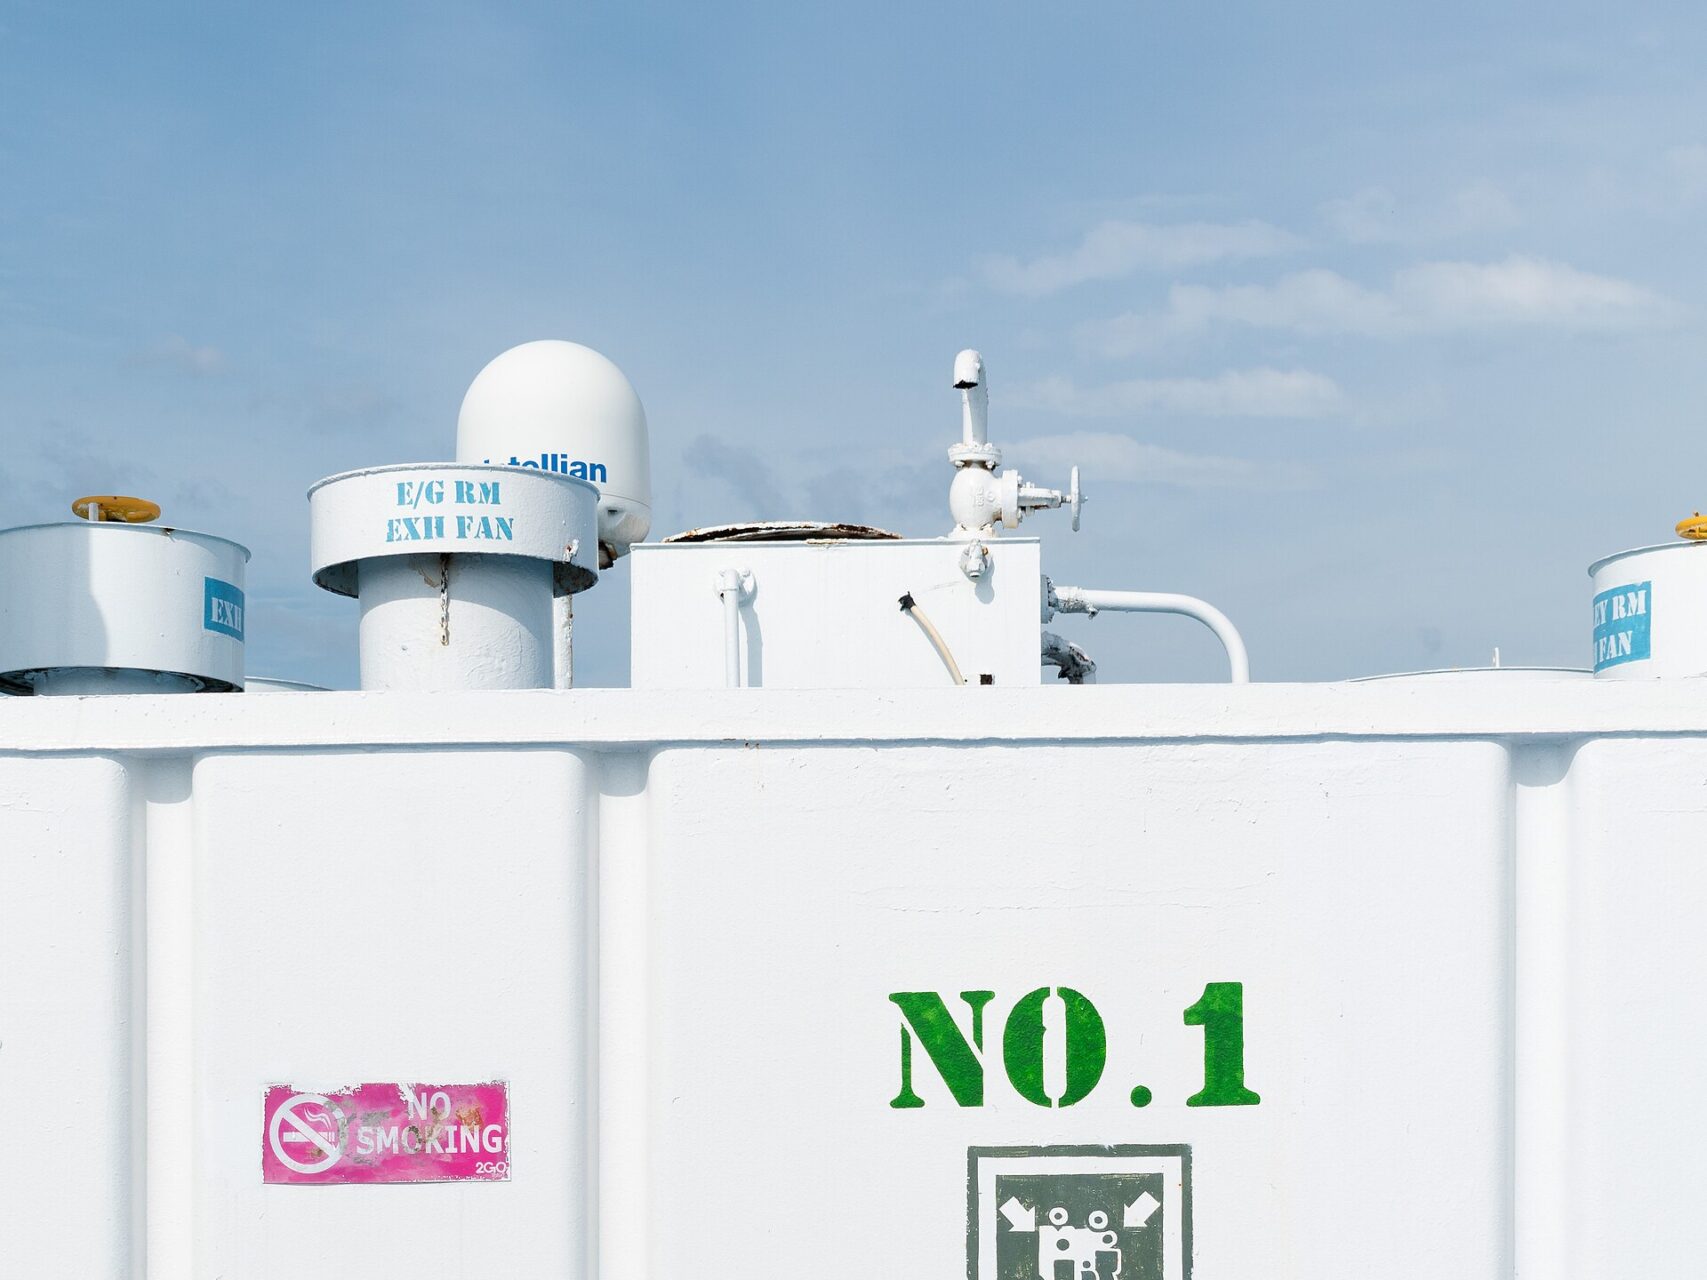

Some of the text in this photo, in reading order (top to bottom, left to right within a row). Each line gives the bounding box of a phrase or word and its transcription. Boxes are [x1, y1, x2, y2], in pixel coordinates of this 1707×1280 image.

[397, 480, 501, 510] E/G RM
[386, 516, 515, 542] EXH FAN
[211, 597, 243, 633] EXH
[1612, 590, 1647, 621] RM
[408, 1092, 450, 1120] NO
[356, 1124, 503, 1154] SMOKING
[475, 1161, 507, 1174] 2GO
